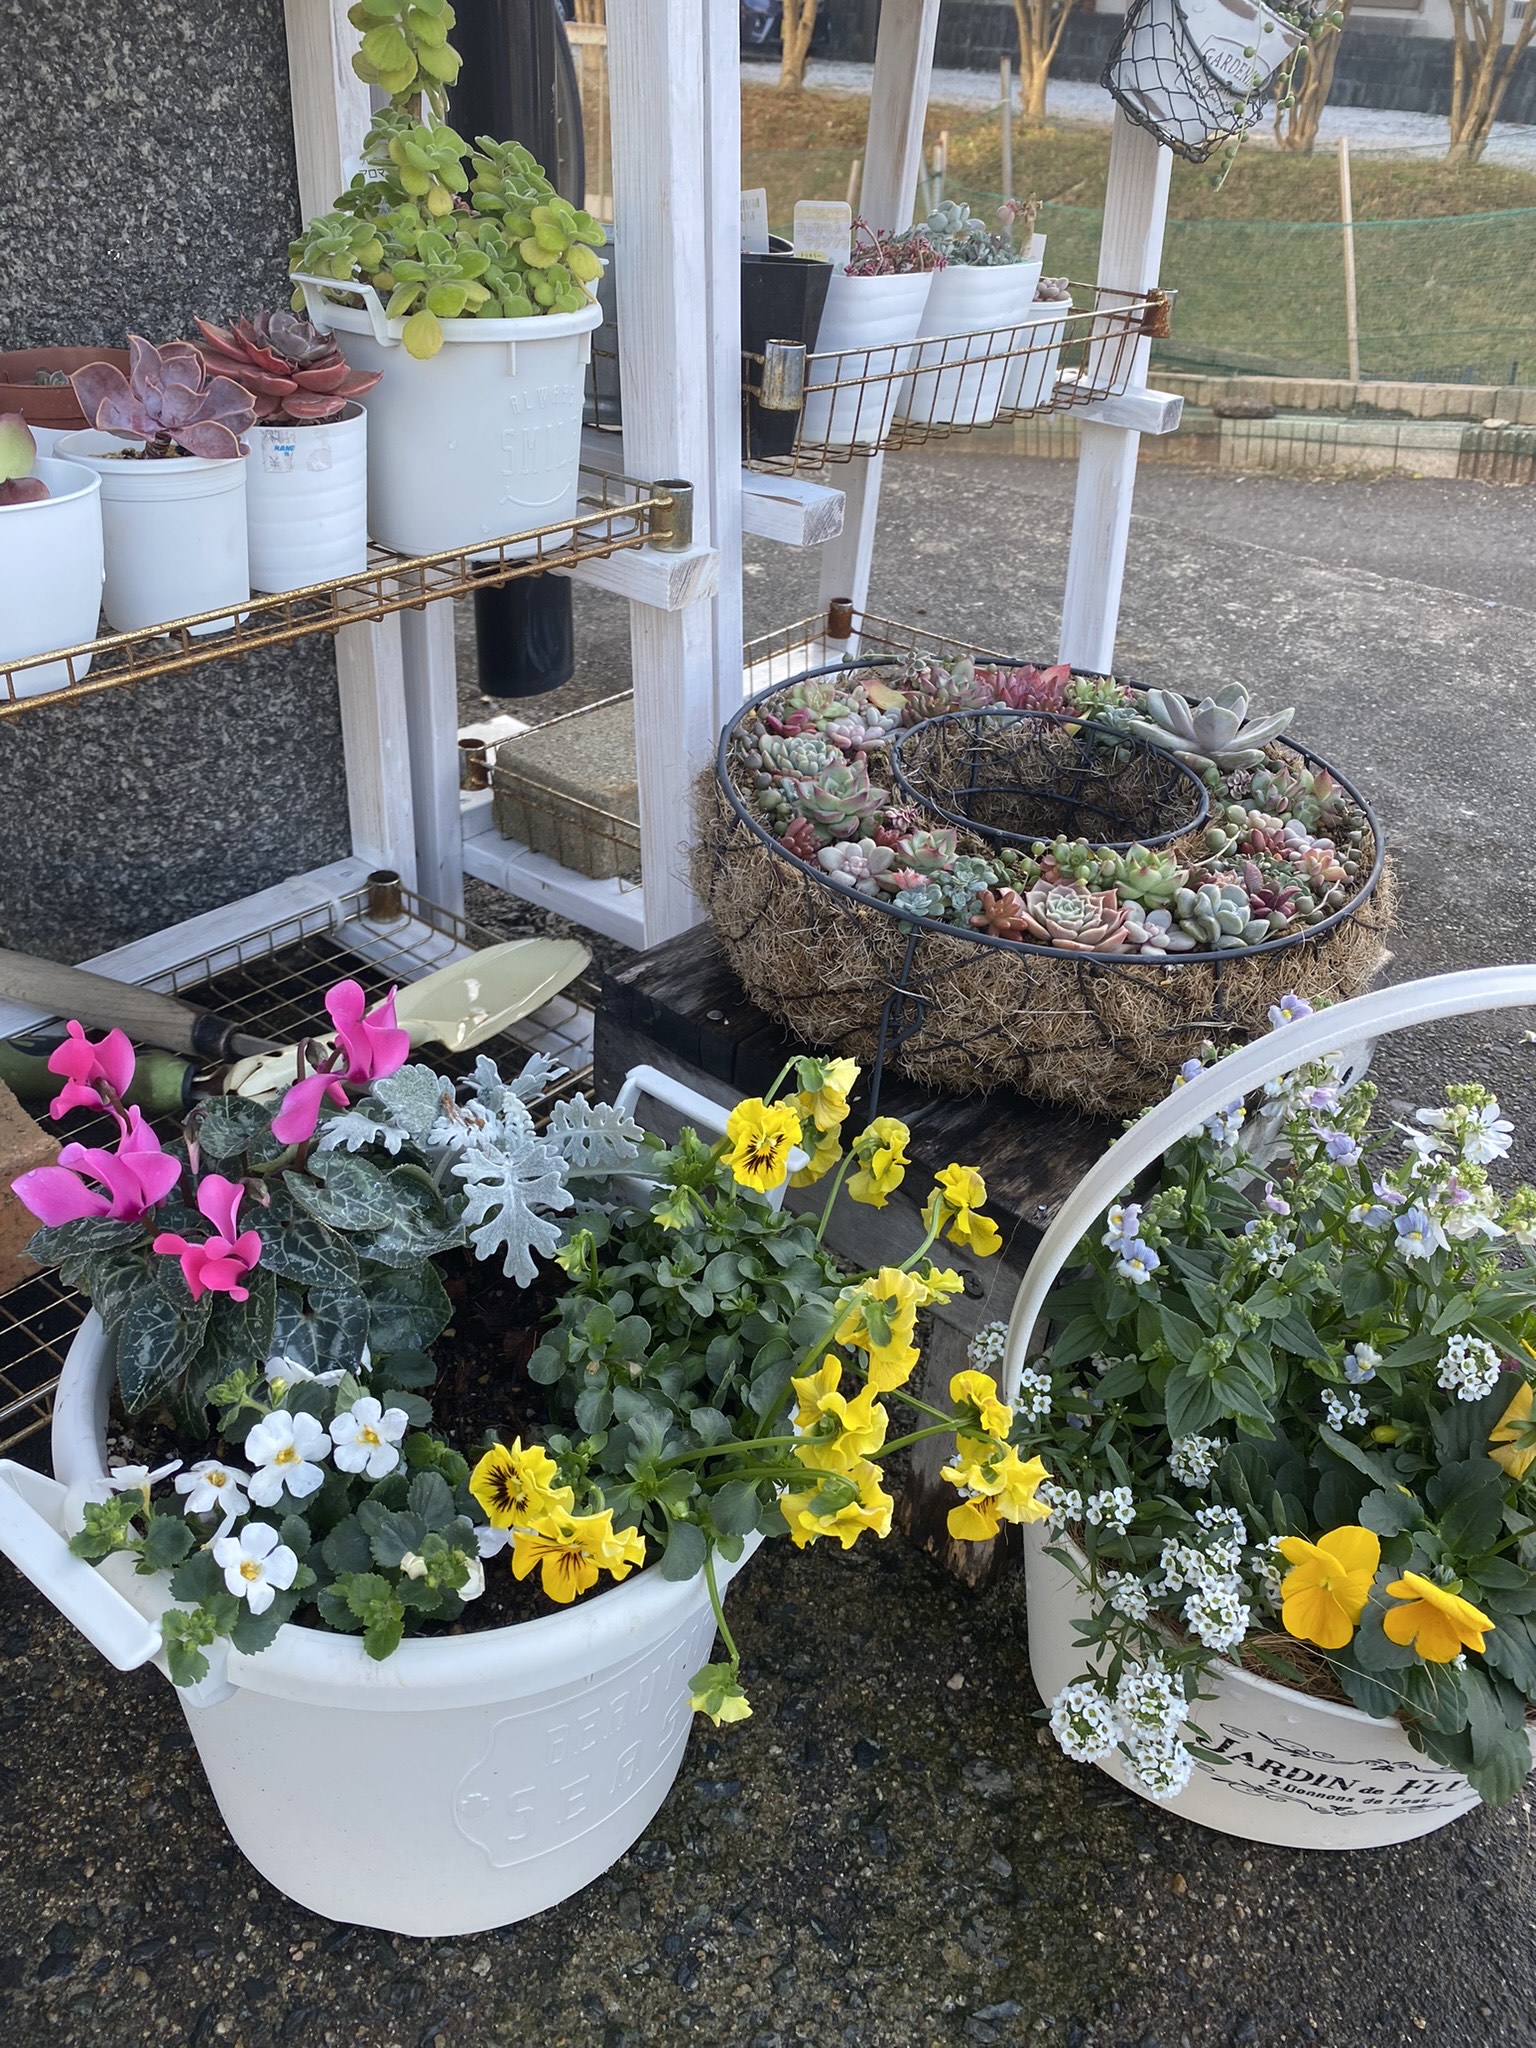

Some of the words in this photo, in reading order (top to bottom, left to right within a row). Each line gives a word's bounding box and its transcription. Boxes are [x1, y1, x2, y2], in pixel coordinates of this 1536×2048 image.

[508, 1690, 686, 1840] SEAS
[1196, 1735, 1360, 1791] JARDIN
[1358, 1786, 1385, 1795] de
